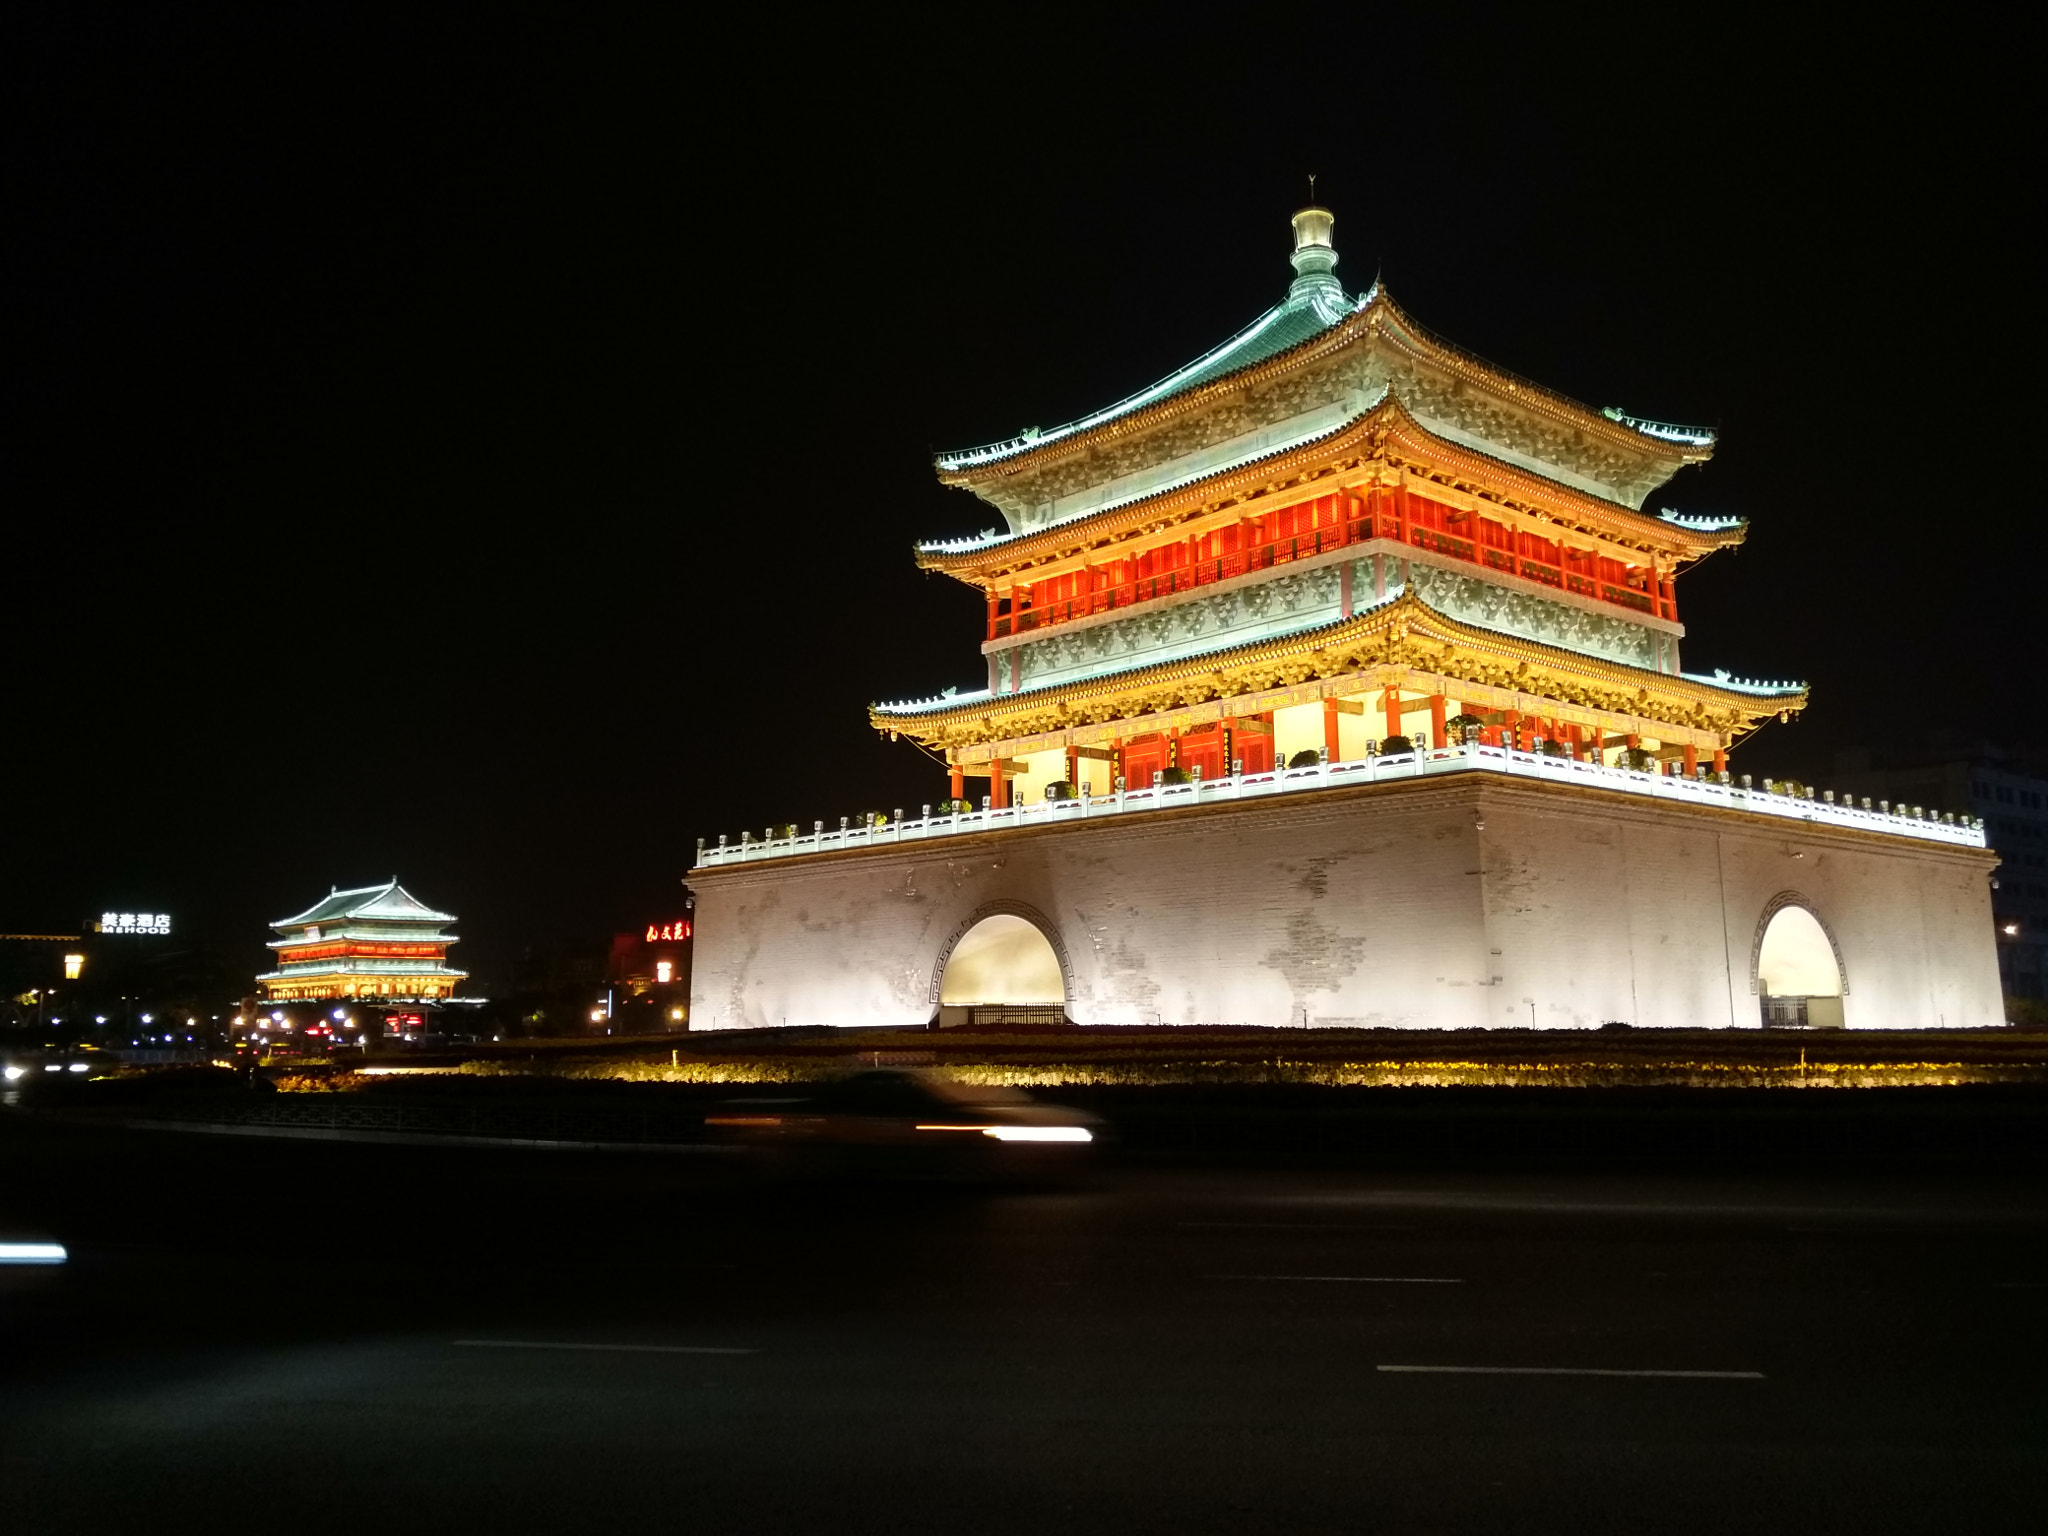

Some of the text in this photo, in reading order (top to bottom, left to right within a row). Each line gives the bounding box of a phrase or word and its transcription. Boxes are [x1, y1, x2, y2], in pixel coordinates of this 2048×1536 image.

[101, 912, 170, 927] 美豪酒店
[101, 926, 170, 935] MEHOOD
